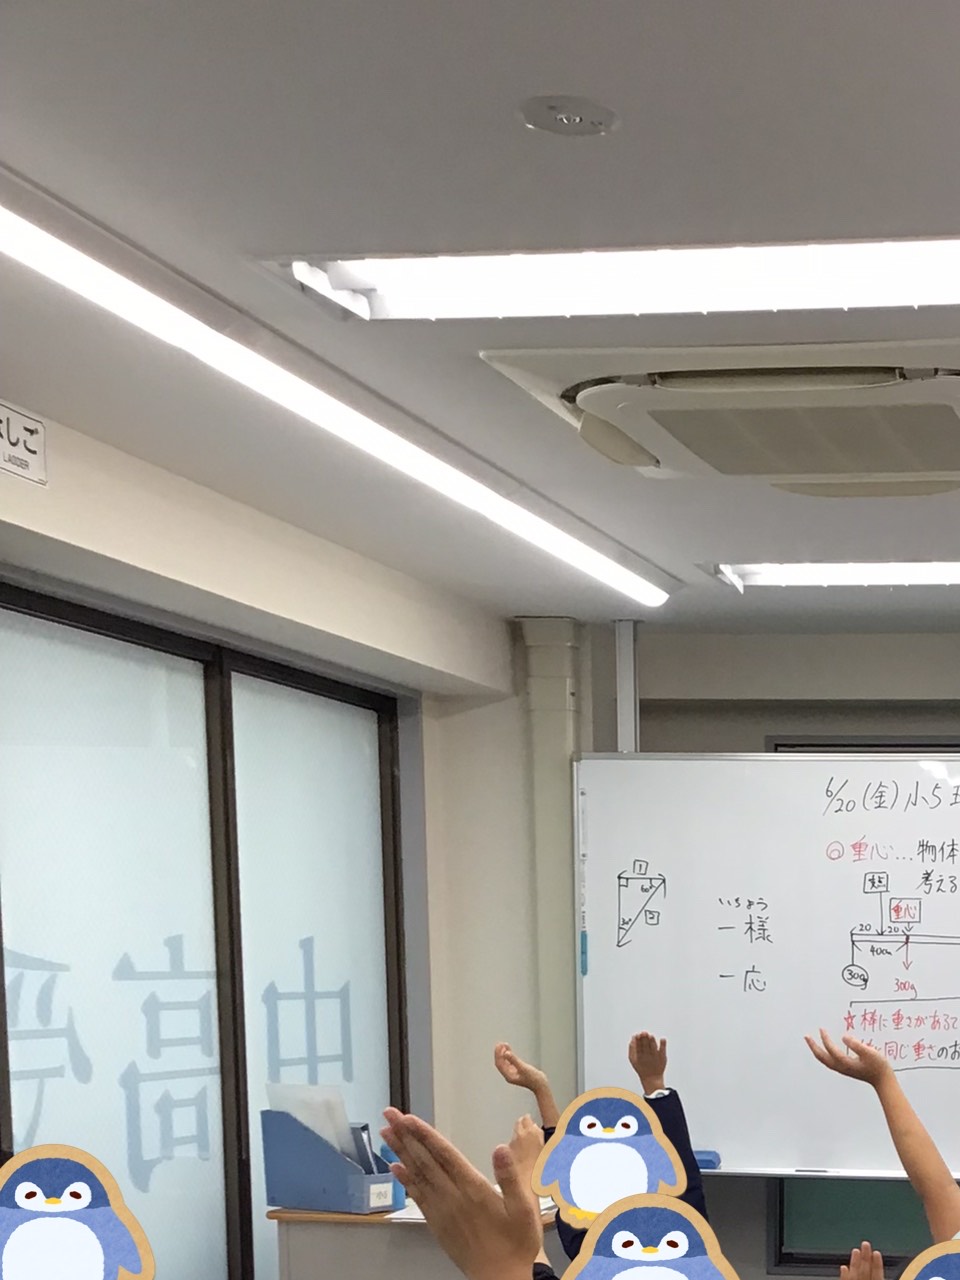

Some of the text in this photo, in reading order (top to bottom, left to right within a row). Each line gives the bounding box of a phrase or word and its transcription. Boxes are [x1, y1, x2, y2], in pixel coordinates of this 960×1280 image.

[0, 416, 39, 455] しご
[891, 900, 917, 920] 重心
[718, 914, 774, 944] 一様
[858, 923, 872, 932] 20
[887, 925, 899, 933] 20
[719, 965, 767, 992] 一応
